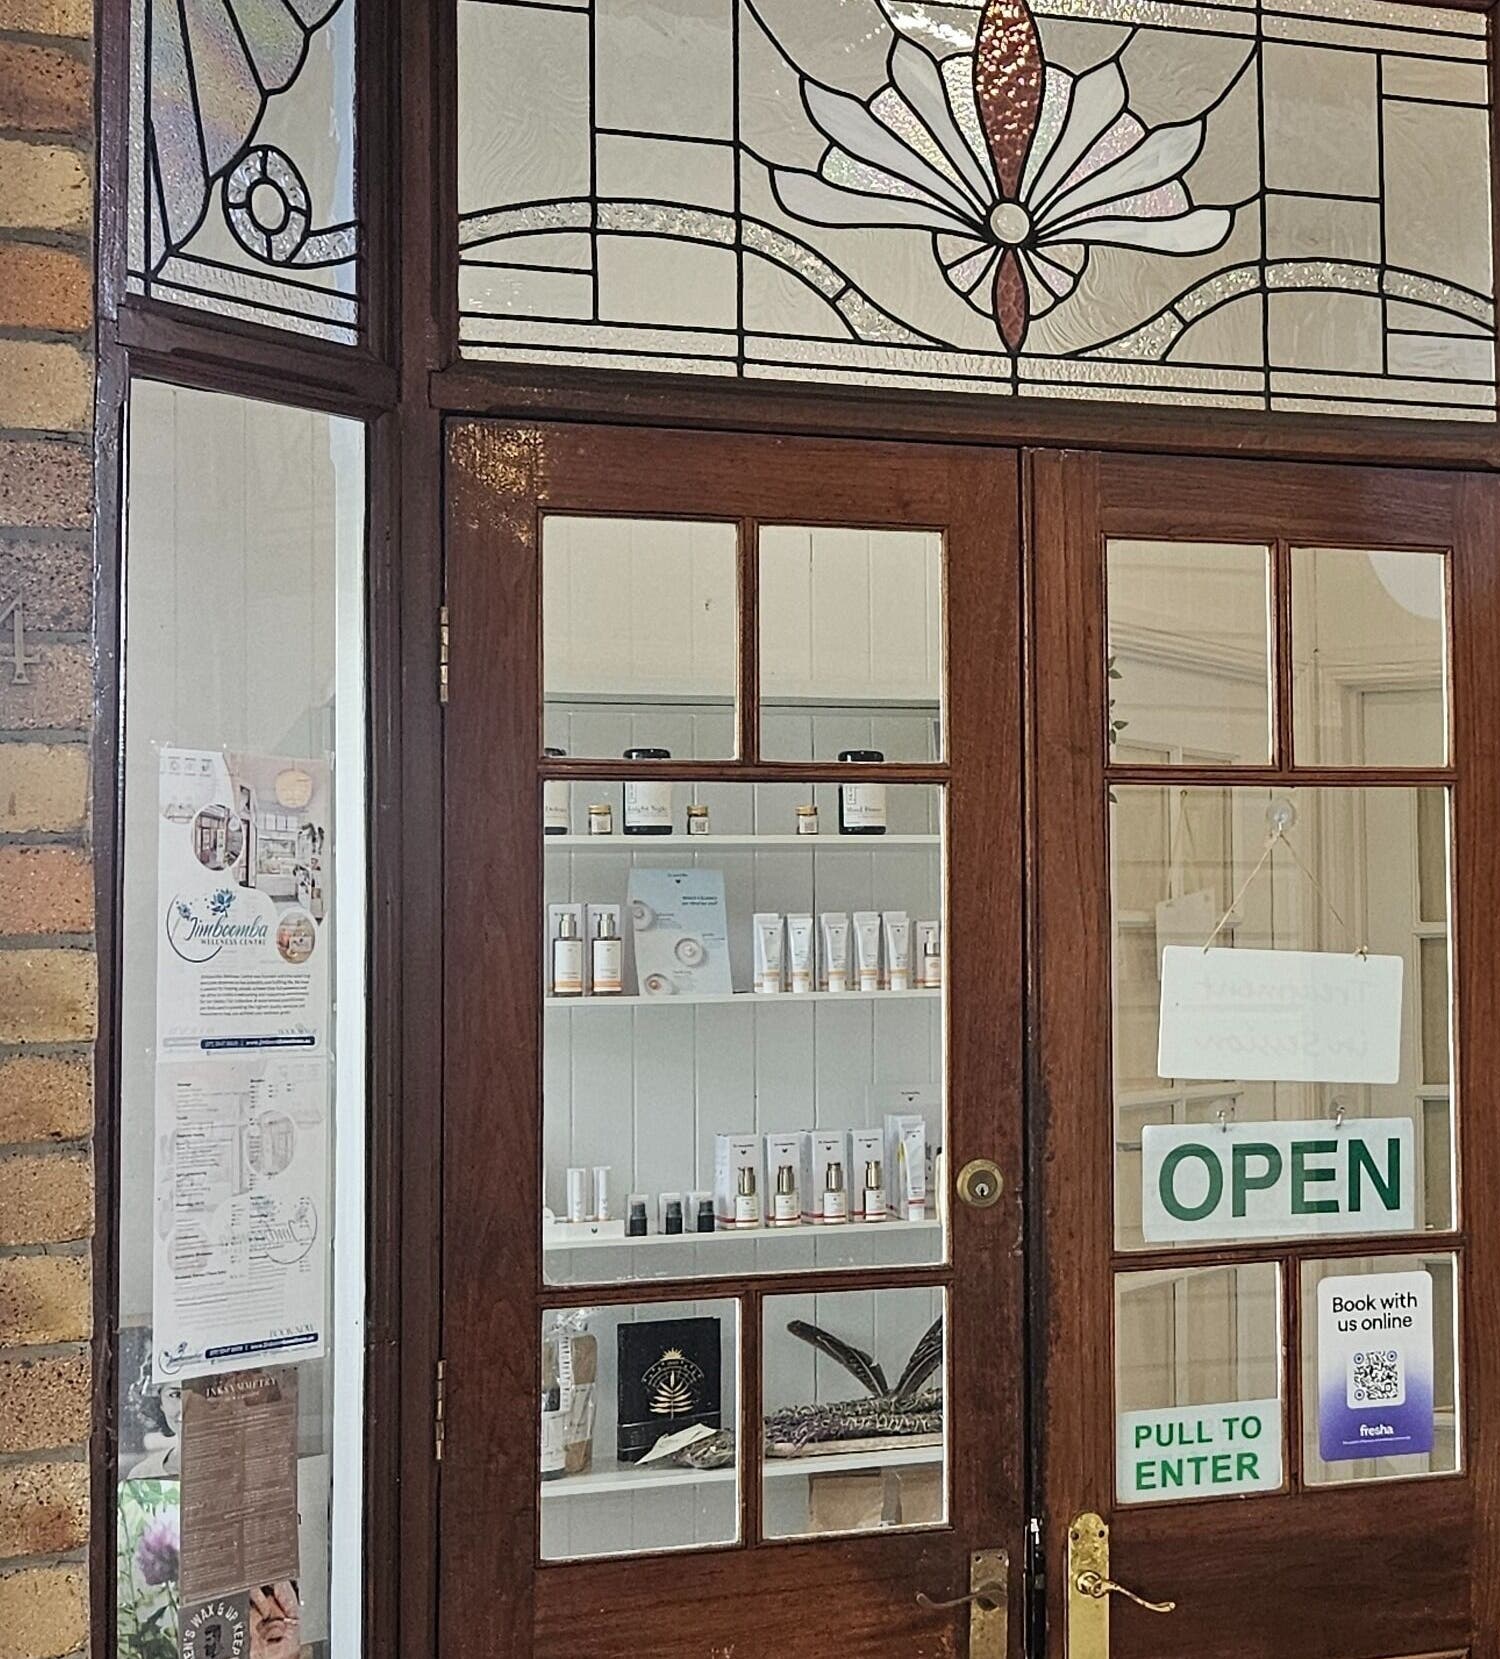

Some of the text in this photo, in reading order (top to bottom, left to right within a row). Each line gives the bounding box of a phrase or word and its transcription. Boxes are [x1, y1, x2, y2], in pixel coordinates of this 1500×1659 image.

[184, 912, 268, 941] Jimboomba
[1158, 1138, 1401, 1222] OPEN
[1332, 1291, 1418, 1313] Book with
[1337, 1312, 1413, 1332] us online
[1135, 1415, 1262, 1449] PULL TO
[1359, 1423, 1394, 1437] fresha
[1135, 1452, 1261, 1491] ENTER
[190, 1603, 215, 1628] WAX
[225, 1605, 239, 1622] UP
[232, 1621, 245, 1655] KEEP
